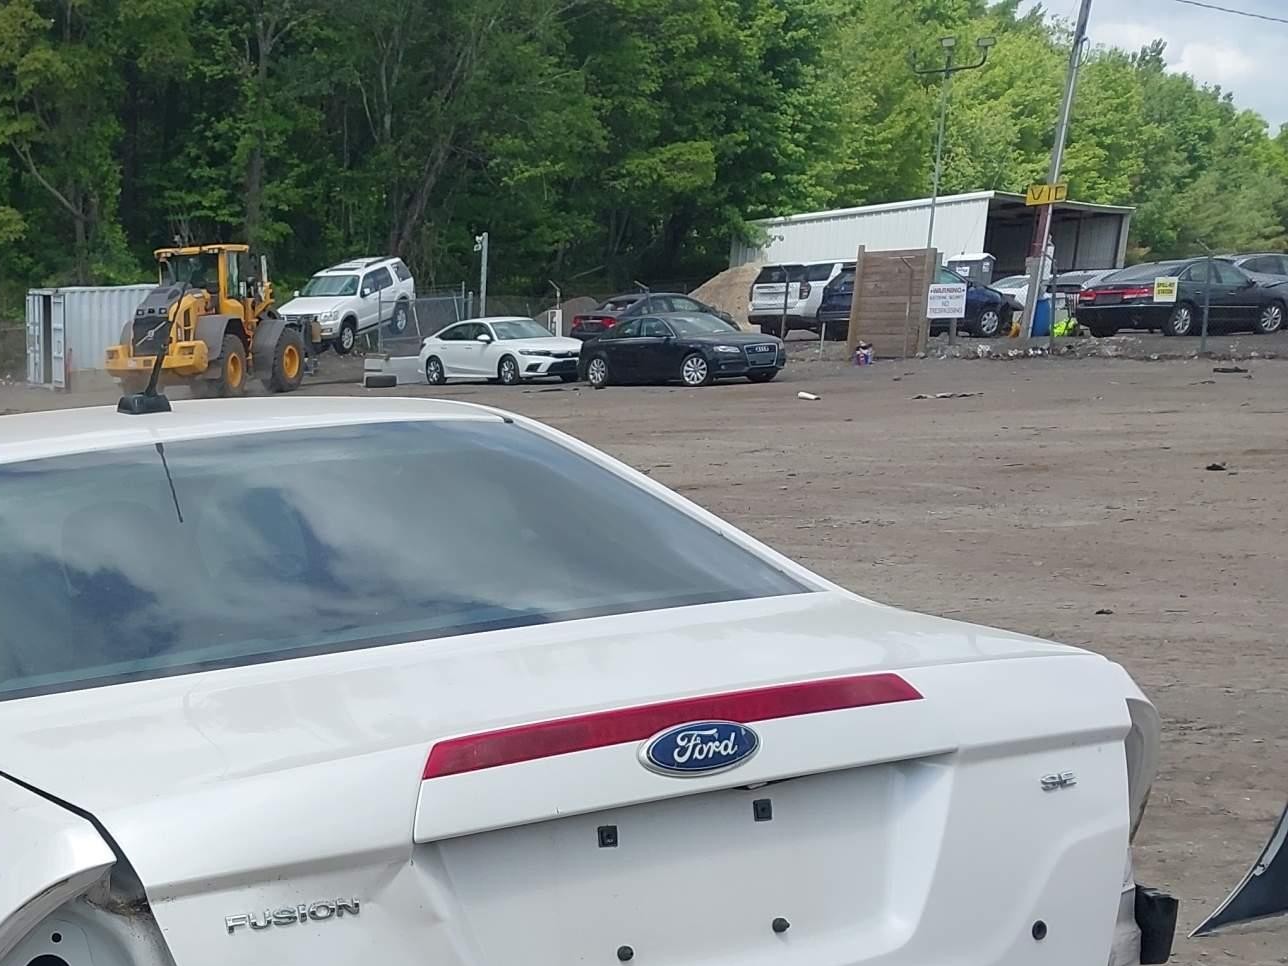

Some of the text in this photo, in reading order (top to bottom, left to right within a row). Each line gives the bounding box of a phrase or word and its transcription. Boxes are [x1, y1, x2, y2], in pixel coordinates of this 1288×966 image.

[673, 728, 738, 763] Ford
[1040, 770, 1077, 792] SE
[224, 897, 360, 934] FUSION
